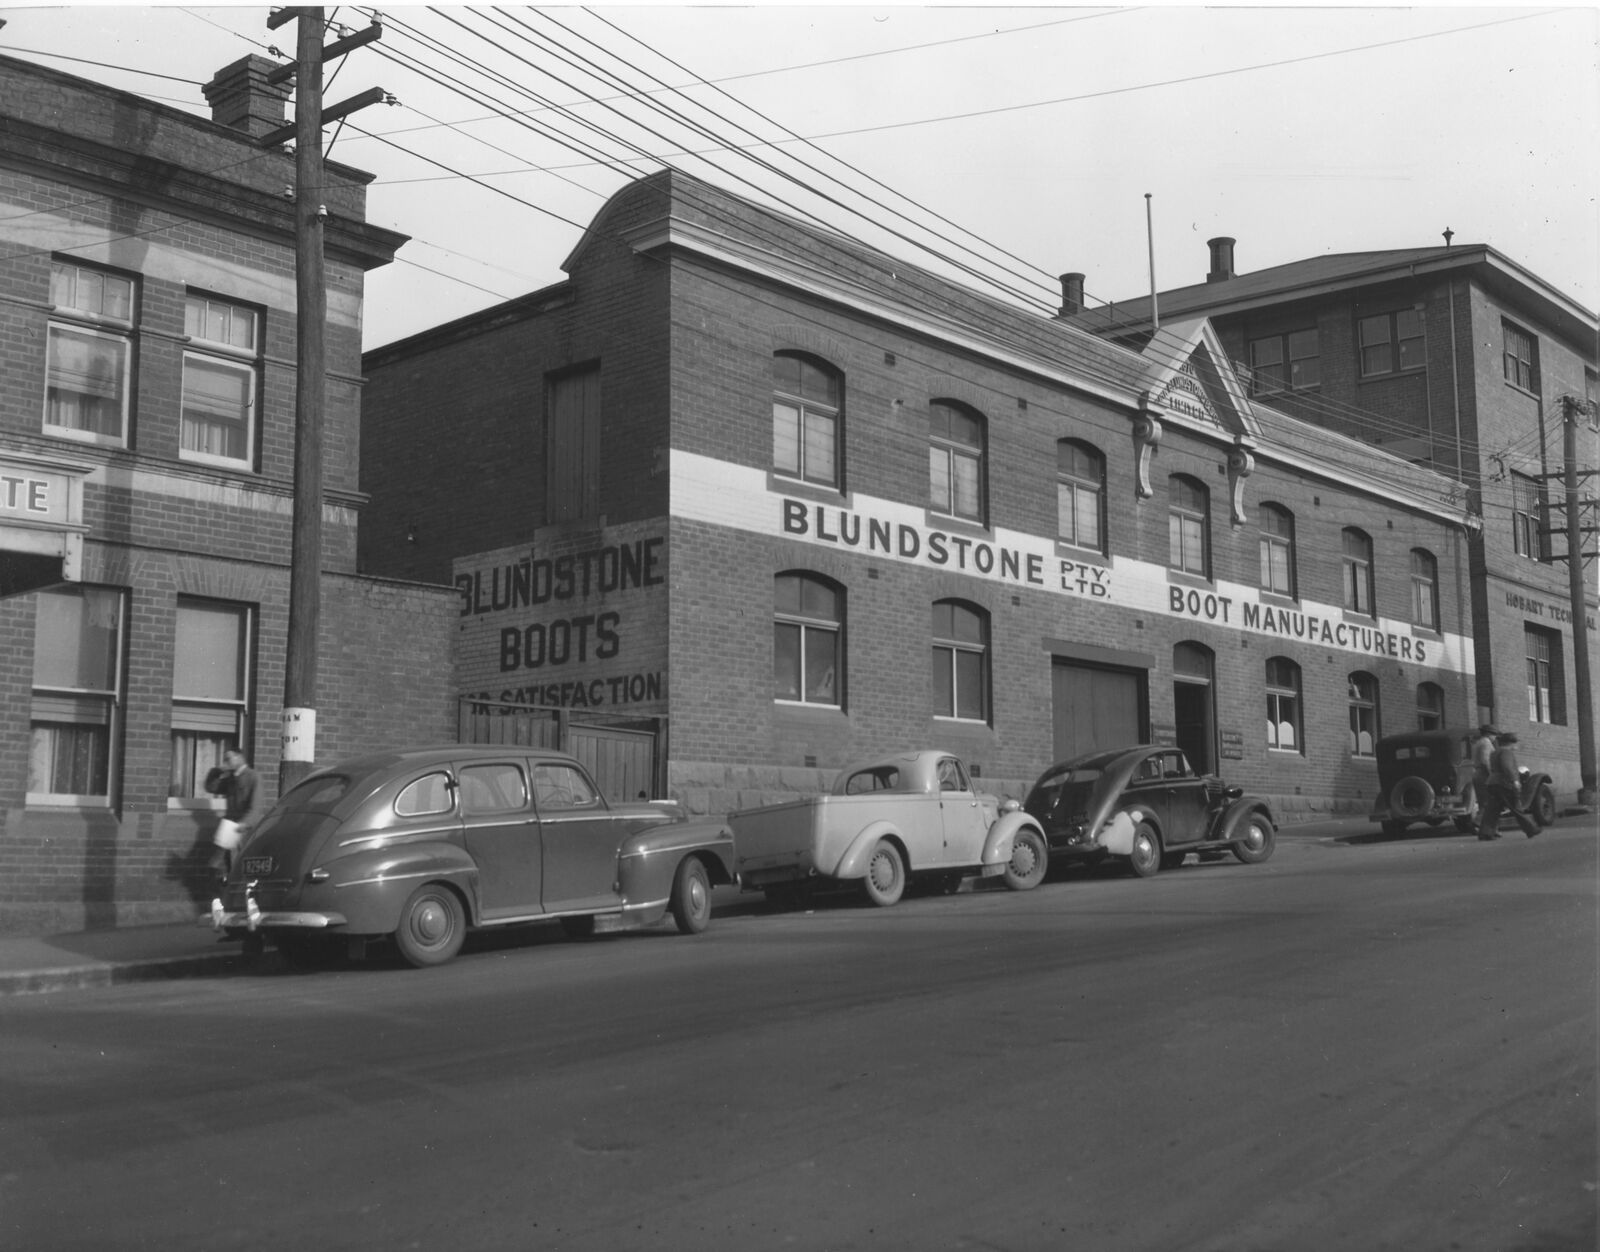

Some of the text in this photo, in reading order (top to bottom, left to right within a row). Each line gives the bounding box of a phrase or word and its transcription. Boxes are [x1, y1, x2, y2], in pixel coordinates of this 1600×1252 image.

[455, 536, 664, 617] BLUNDSTONE
[784, 498, 1044, 585] BLUNDSTONE
[1169, 585, 1426, 662] BOOT MANUFACTURERS
[1505, 592, 1544, 616] HOBART
[500, 610, 621, 673] BOOTS
[500, 671, 661, 716] SATISFACTION
